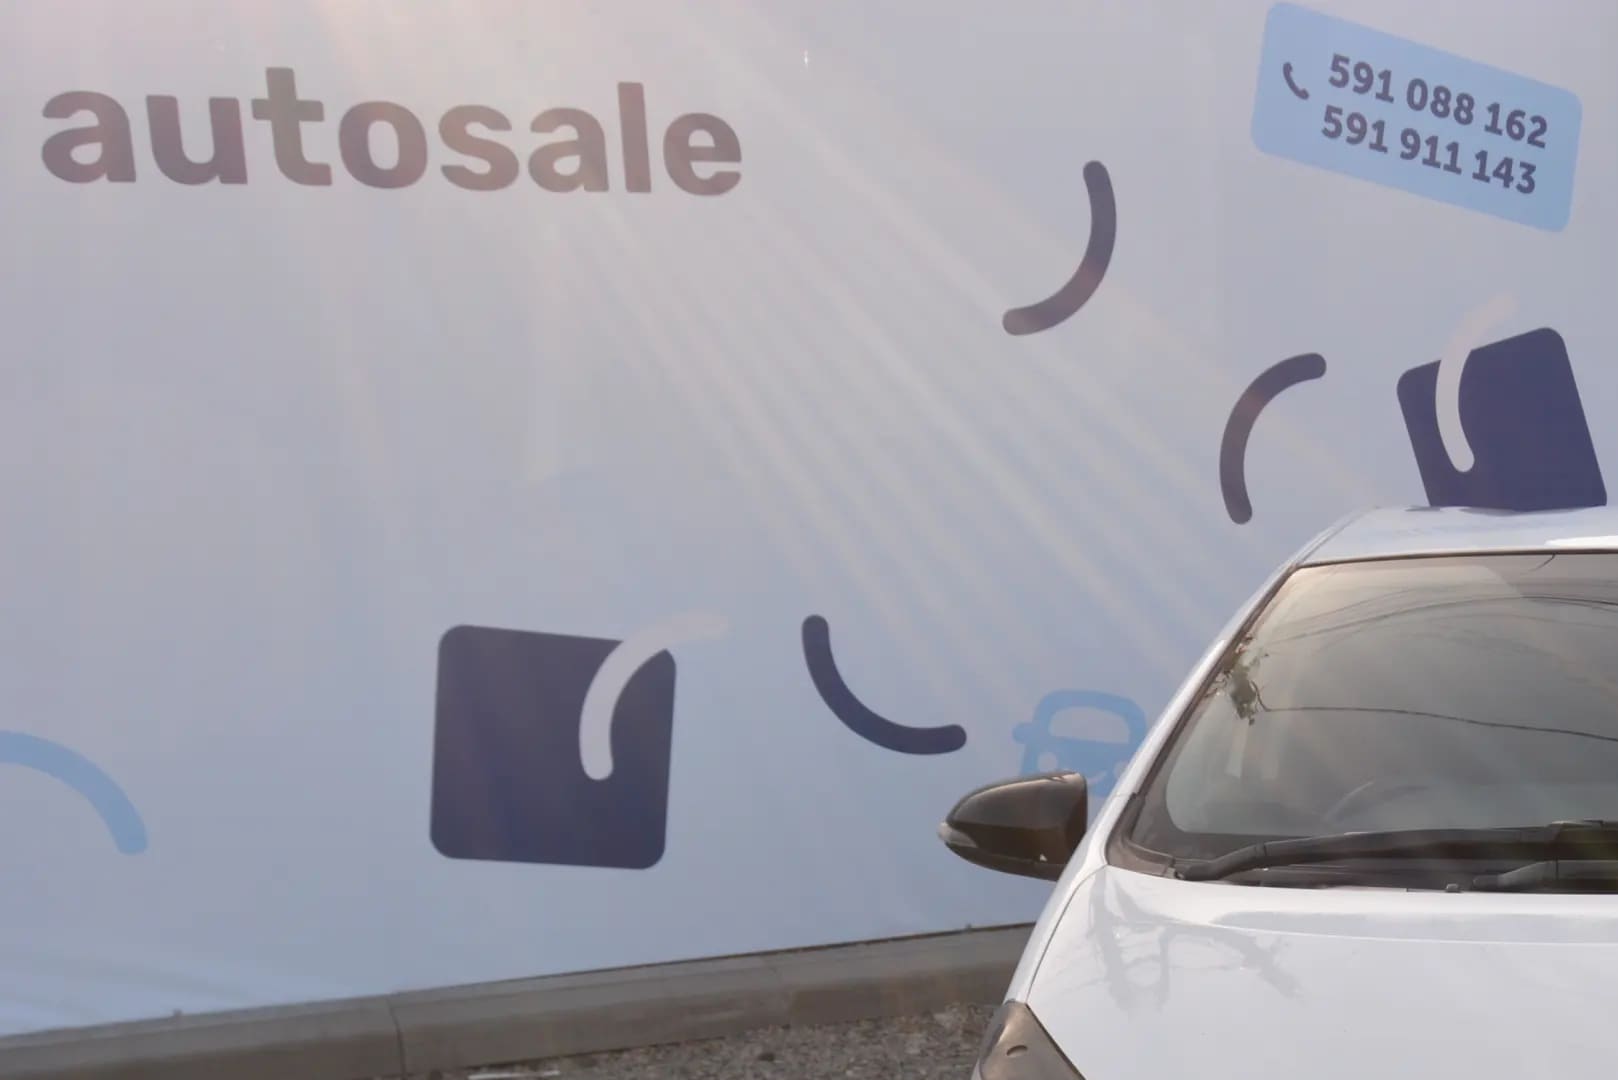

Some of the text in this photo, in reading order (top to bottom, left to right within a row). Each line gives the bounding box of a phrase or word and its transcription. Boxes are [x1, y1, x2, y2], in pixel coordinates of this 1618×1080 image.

[41, 67, 742, 196] autosale
[1321, 104, 1536, 194] 591 911 143
[1328, 53, 1548, 149] 591 088 162
